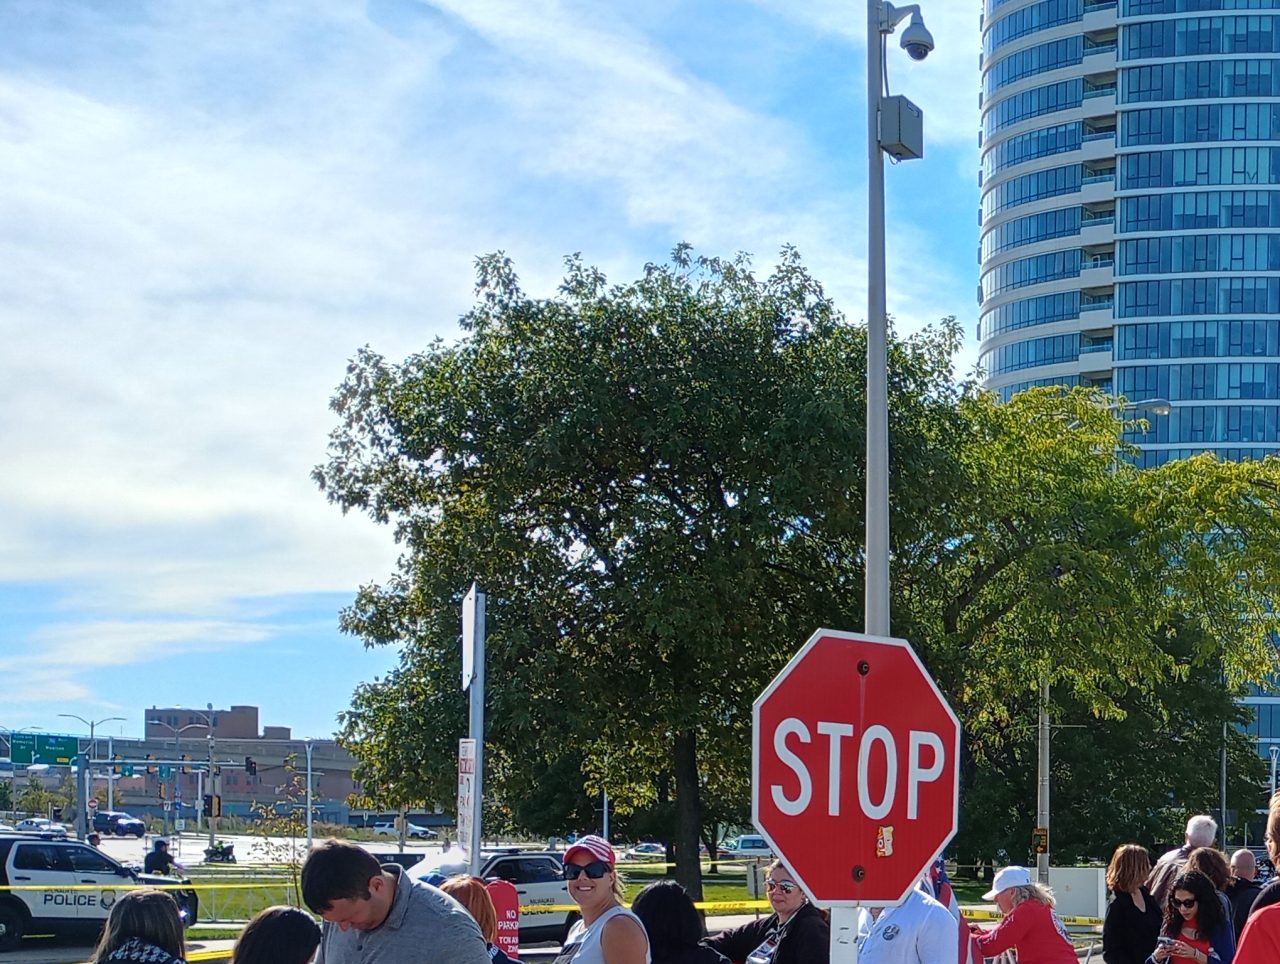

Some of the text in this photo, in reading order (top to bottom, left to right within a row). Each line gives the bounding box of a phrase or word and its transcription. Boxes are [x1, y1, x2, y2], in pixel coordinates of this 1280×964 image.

[771, 717, 945, 820] STOP
[43, 894, 97, 906] POLICE
[506, 910, 517, 919] NO
